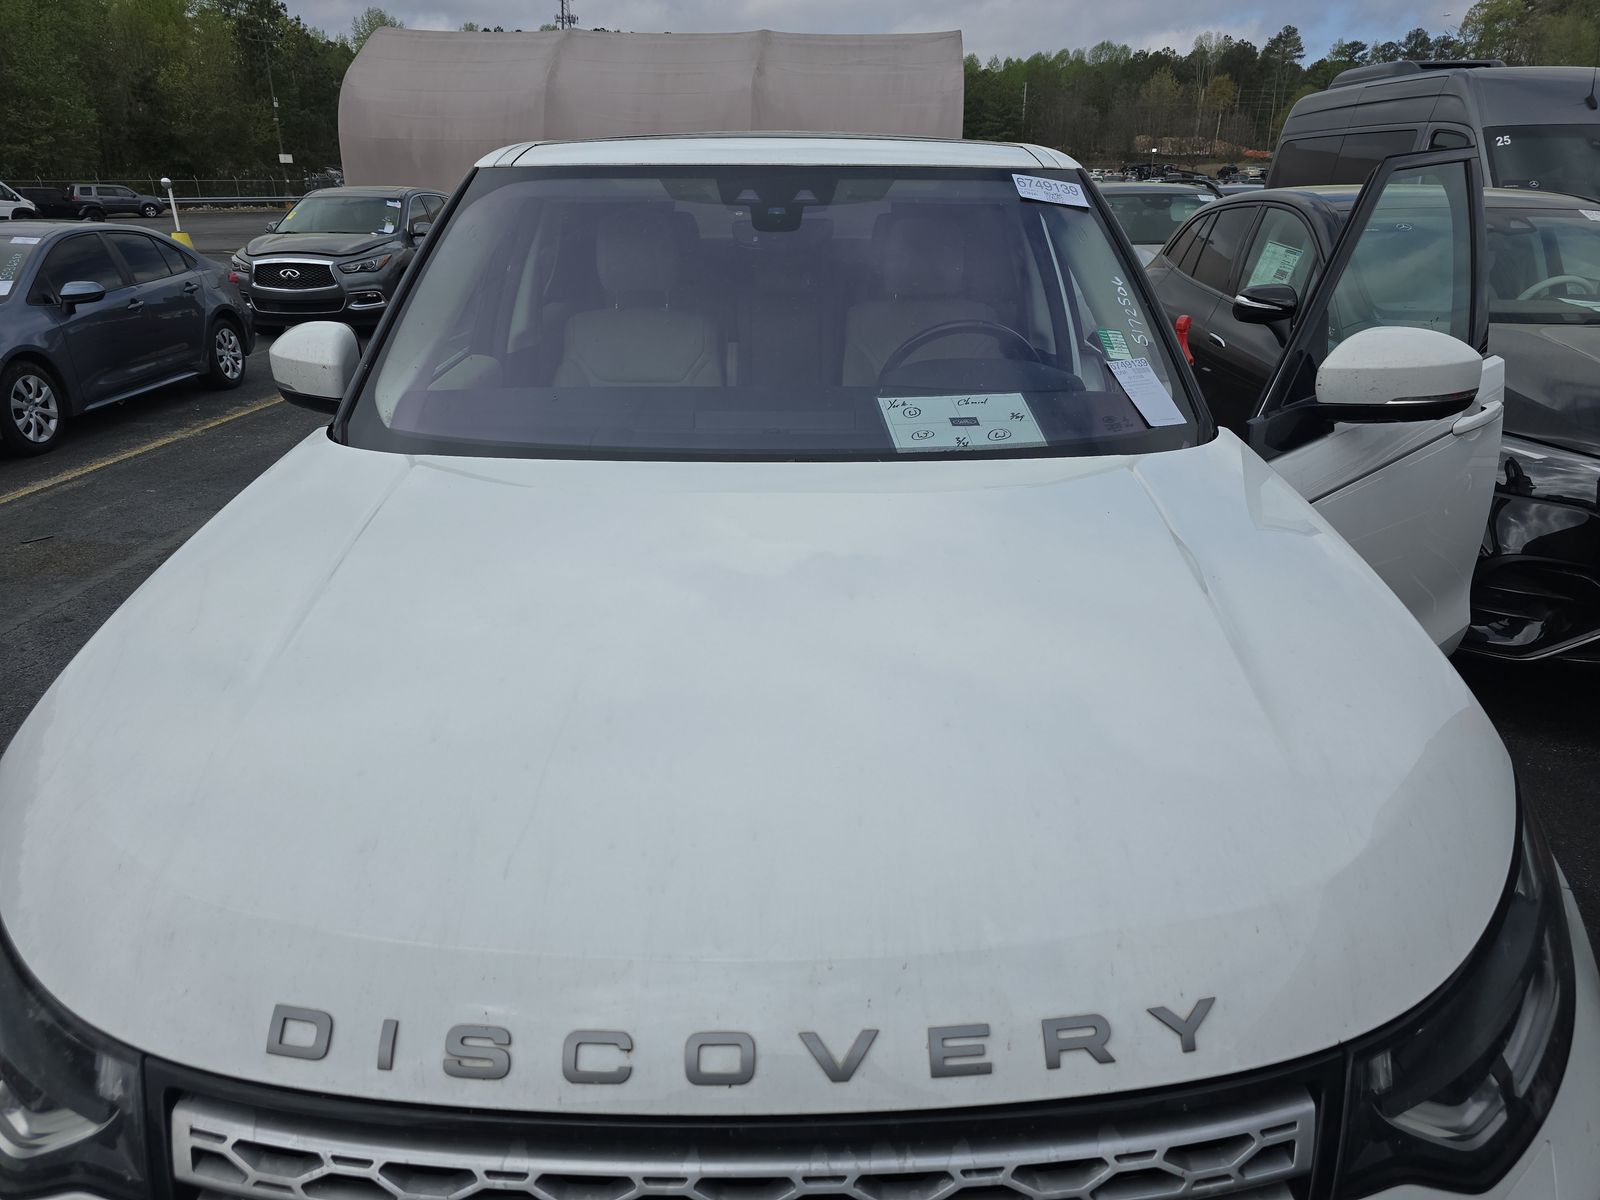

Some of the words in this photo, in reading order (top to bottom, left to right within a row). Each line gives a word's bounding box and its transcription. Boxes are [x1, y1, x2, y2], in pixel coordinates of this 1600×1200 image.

[1495, 135, 1512, 147] 25
[1016, 177, 1079, 197] 6749139
[1110, 358, 1148, 370] 6749139
[266, 996, 1216, 1085] DISCOVERY
